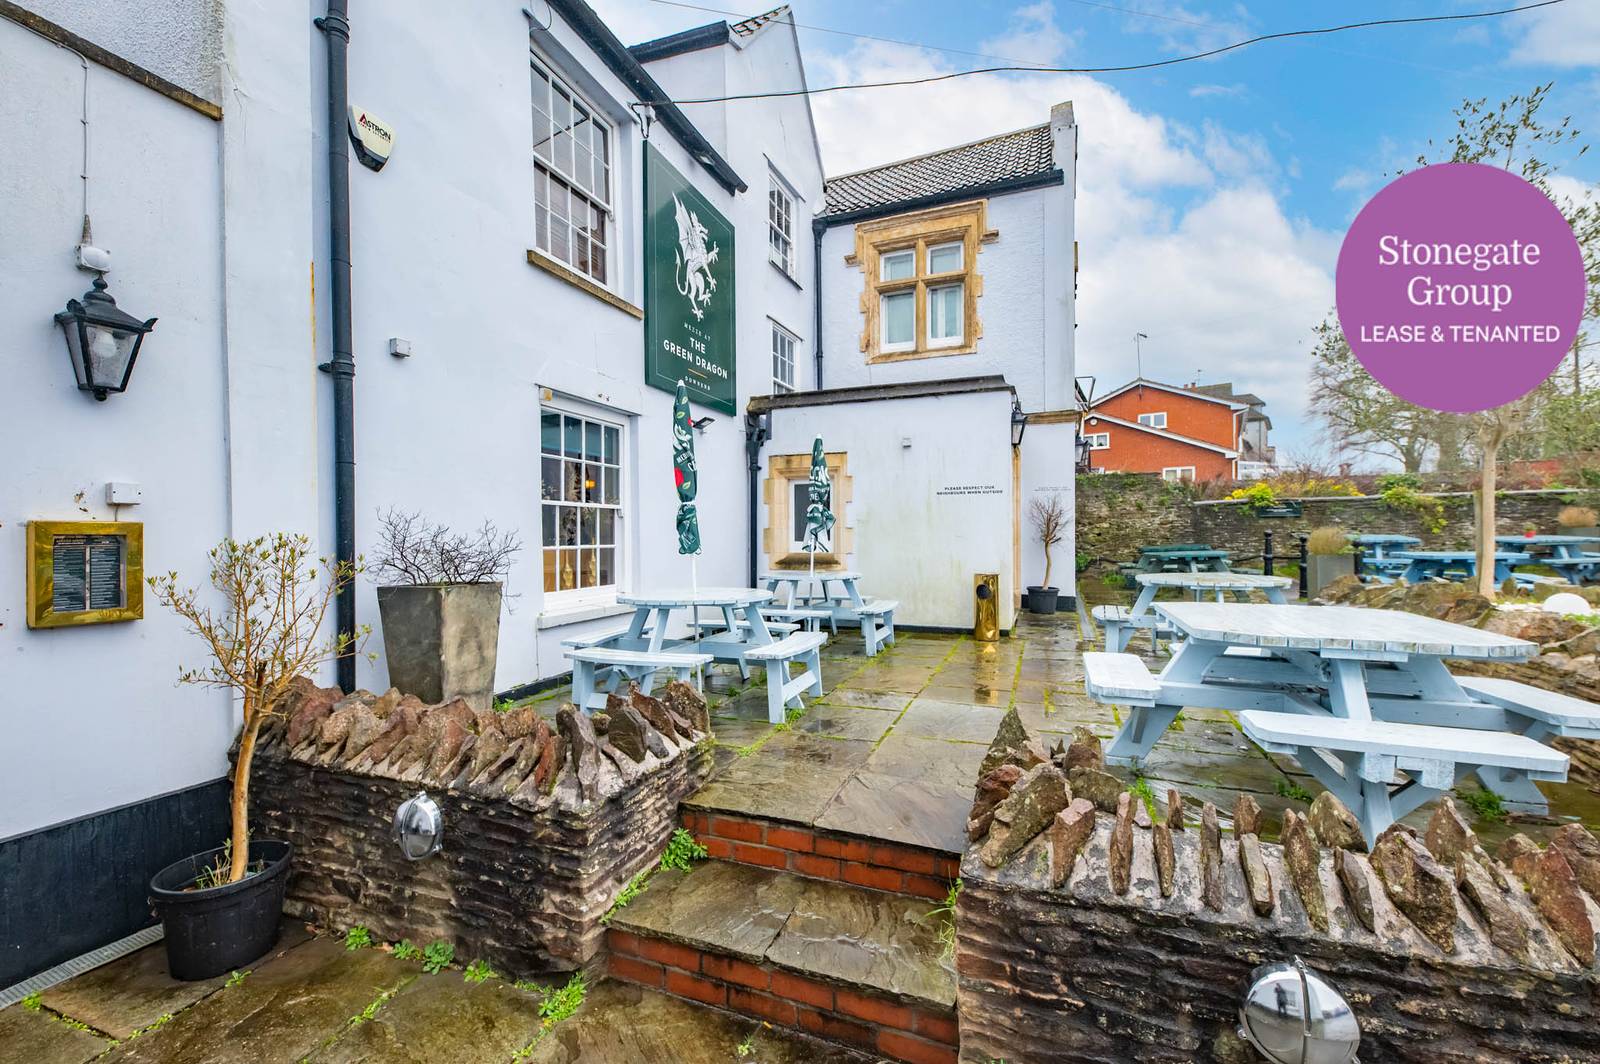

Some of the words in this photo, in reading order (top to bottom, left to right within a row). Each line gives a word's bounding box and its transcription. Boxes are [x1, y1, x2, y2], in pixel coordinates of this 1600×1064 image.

[359, 113, 391, 141] ASTRON
[663, 339, 693, 363] GREEN
[695, 355, 728, 379] DRAGON
[689, 337, 706, 354] THE
